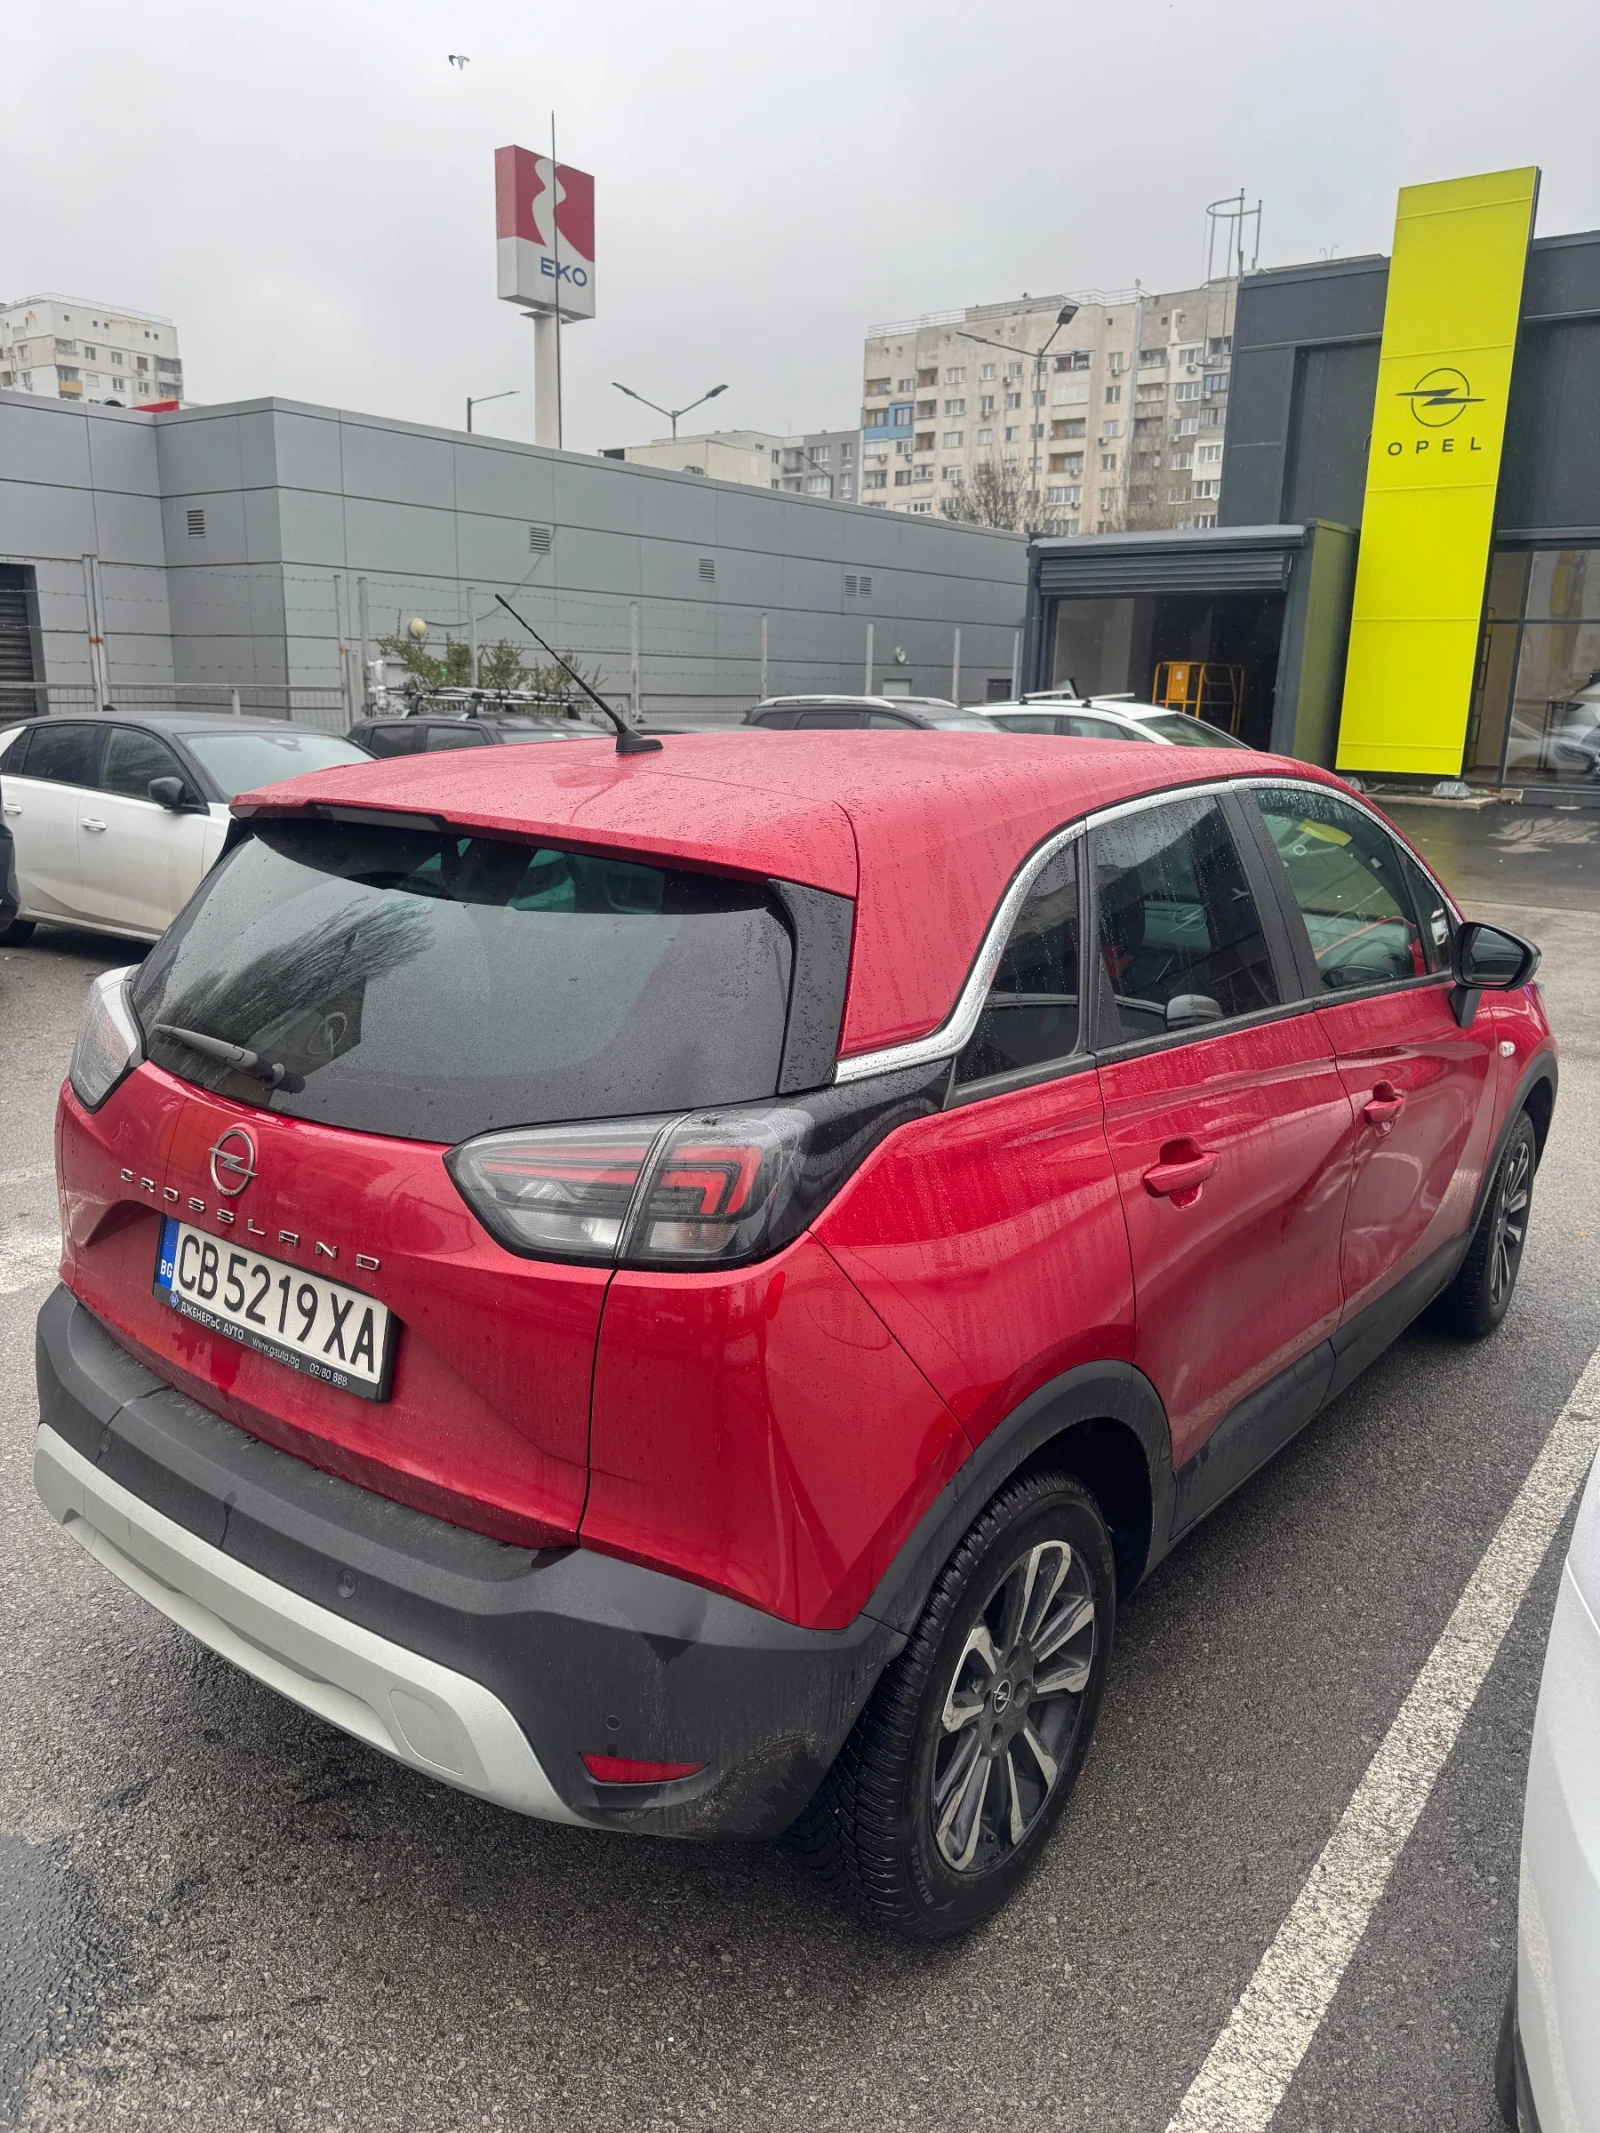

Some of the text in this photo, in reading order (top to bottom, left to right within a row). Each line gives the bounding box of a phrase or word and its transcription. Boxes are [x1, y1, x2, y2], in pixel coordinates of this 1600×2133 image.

[540, 256, 588, 287] EKO
[1388, 437, 1482, 456] OPEL
[120, 1168, 380, 1272] CROSSLAND
[160, 1258, 173, 1279] BG
[223, 1323, 244, 1340] АУТО
